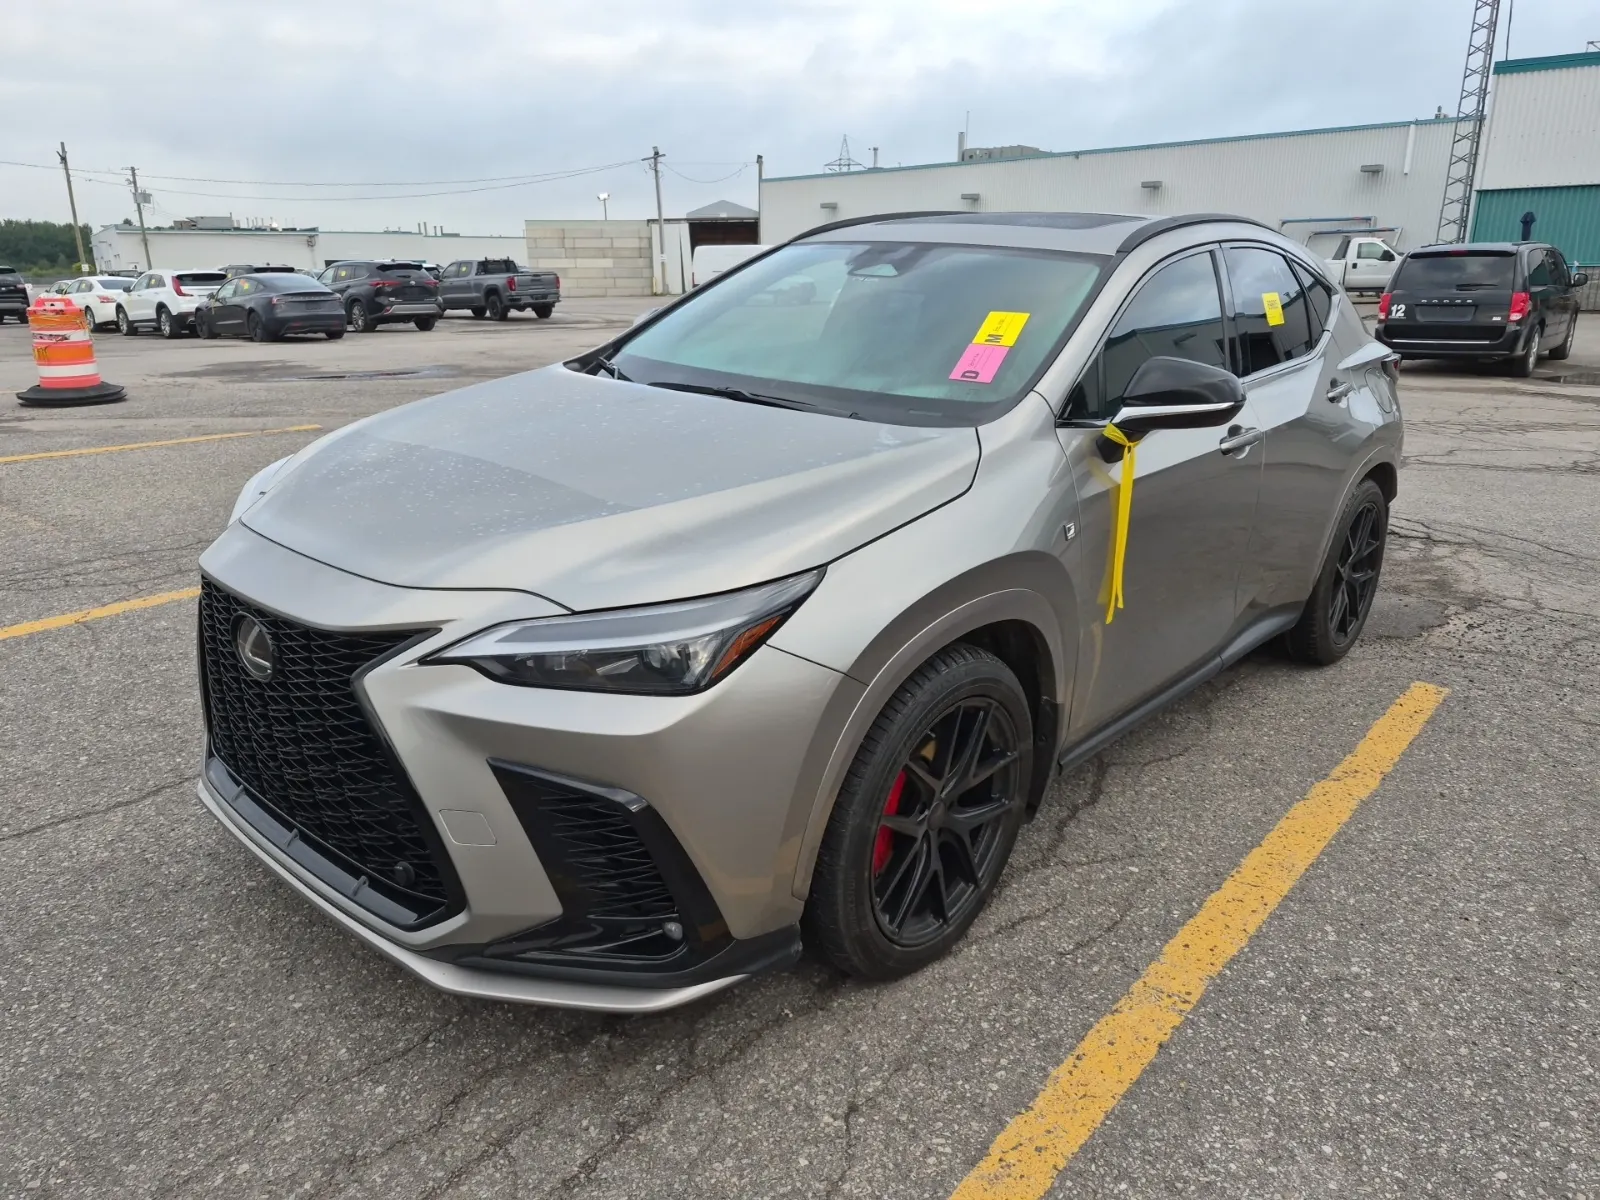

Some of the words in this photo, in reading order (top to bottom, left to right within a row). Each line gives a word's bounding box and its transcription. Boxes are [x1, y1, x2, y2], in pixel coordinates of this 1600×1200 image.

[1391, 304, 1406, 317] 12
[984, 334, 1004, 343] M
[960, 370, 980, 380] D
